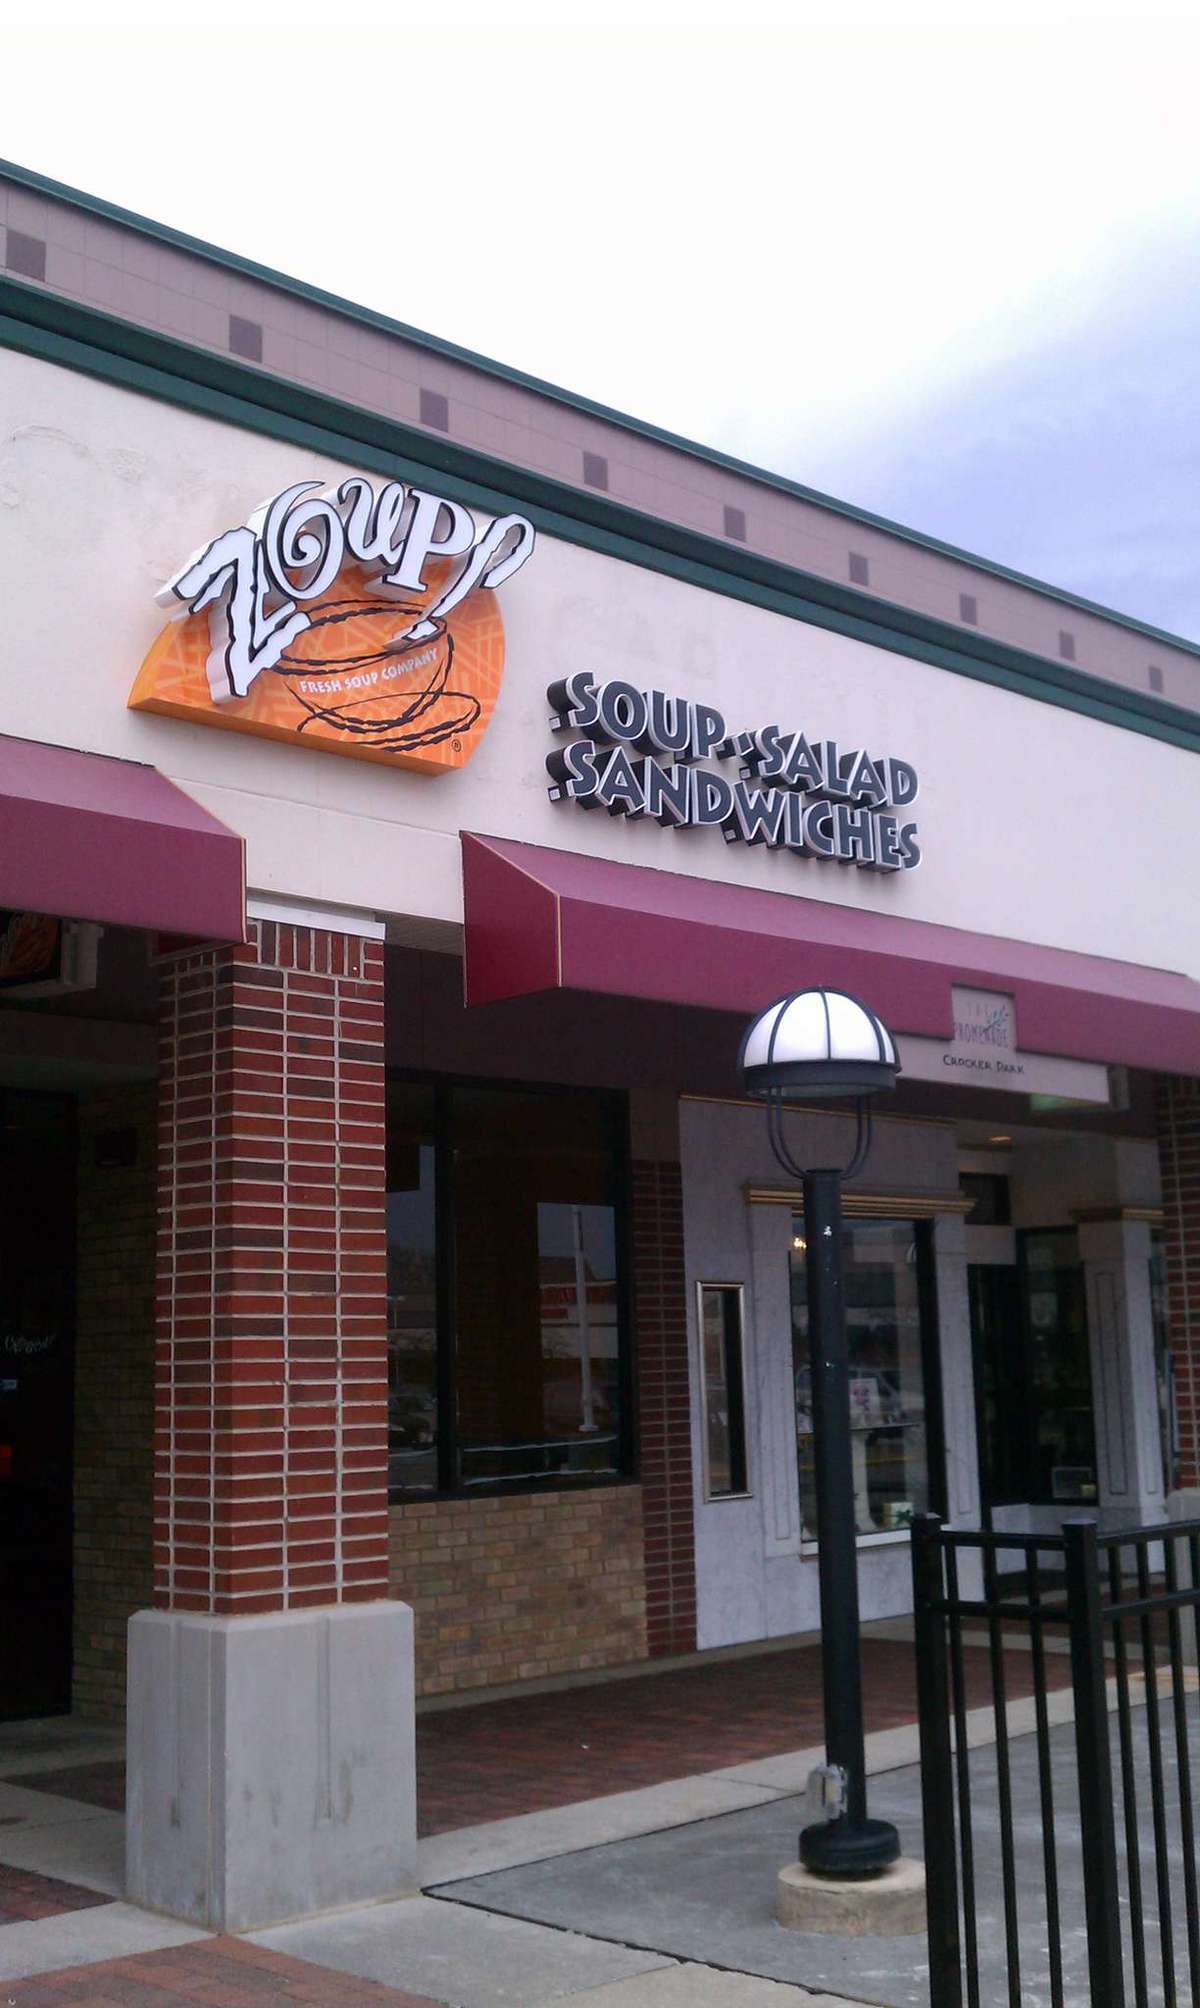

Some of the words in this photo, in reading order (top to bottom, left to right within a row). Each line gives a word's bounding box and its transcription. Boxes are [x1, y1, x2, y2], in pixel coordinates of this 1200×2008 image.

[300, 680, 342, 694] FRESH
[344, 673, 378, 690] SOUP
[381, 648, 437, 680] COMPANY
[568, 671, 726, 760] SOUP
[755, 724, 918, 807] SALAD
[564, 740, 922, 871] SANDWICHES
